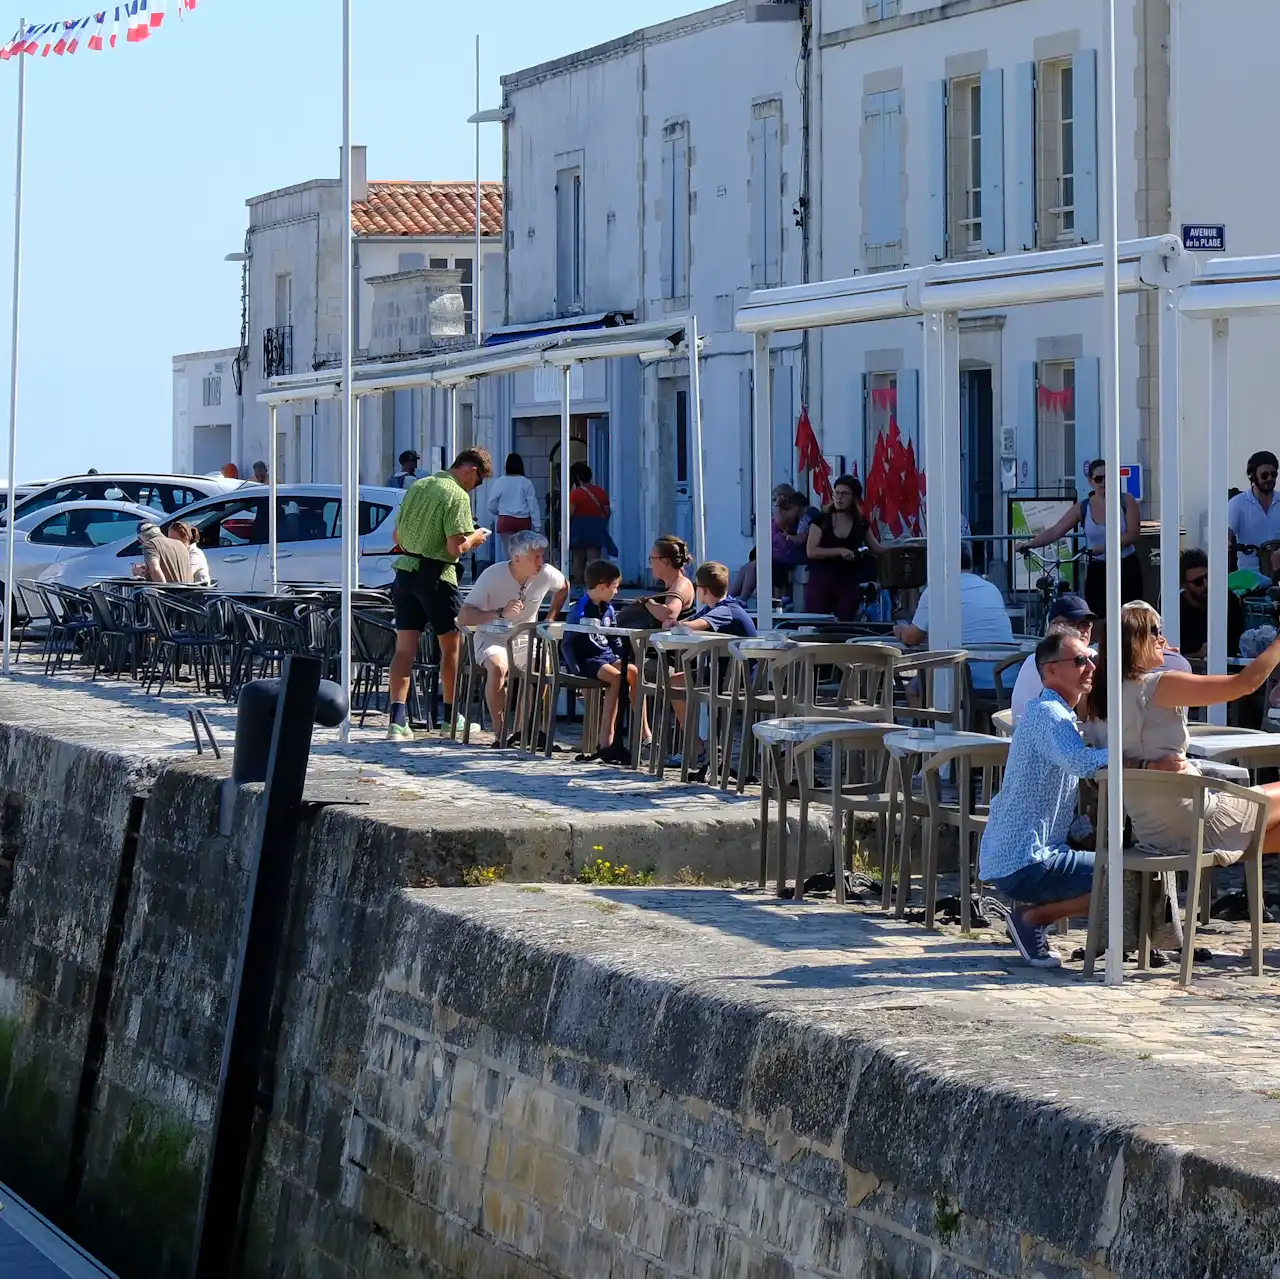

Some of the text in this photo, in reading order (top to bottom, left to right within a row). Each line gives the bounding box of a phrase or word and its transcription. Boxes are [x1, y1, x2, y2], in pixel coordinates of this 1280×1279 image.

[1190, 228, 1217, 237] AVENUE
[1185, 238, 1221, 247] de la PLAGE
